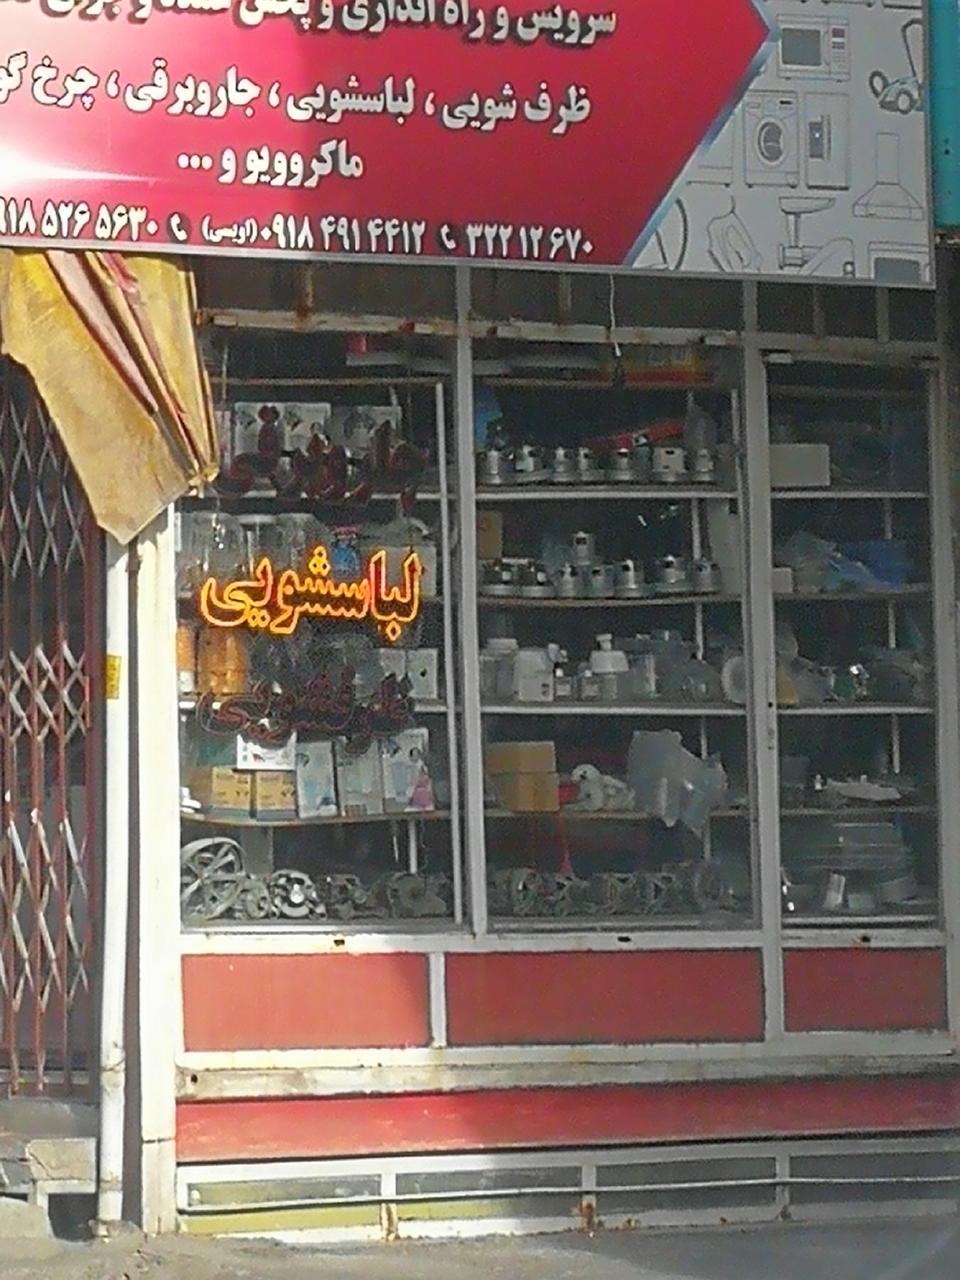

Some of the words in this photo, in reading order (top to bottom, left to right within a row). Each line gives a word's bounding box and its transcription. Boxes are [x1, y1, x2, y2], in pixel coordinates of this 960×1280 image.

[493, 6, 508, 39] و
[517, 3, 617, 44] سرویس
[32, 55, 99, 110] چرخ
[524, 82, 591, 134] ظرف
[218, 148, 237, 184] و
[241, 139, 364, 188] ماکروویو
[200, 545, 423, 641] لباسشویی
